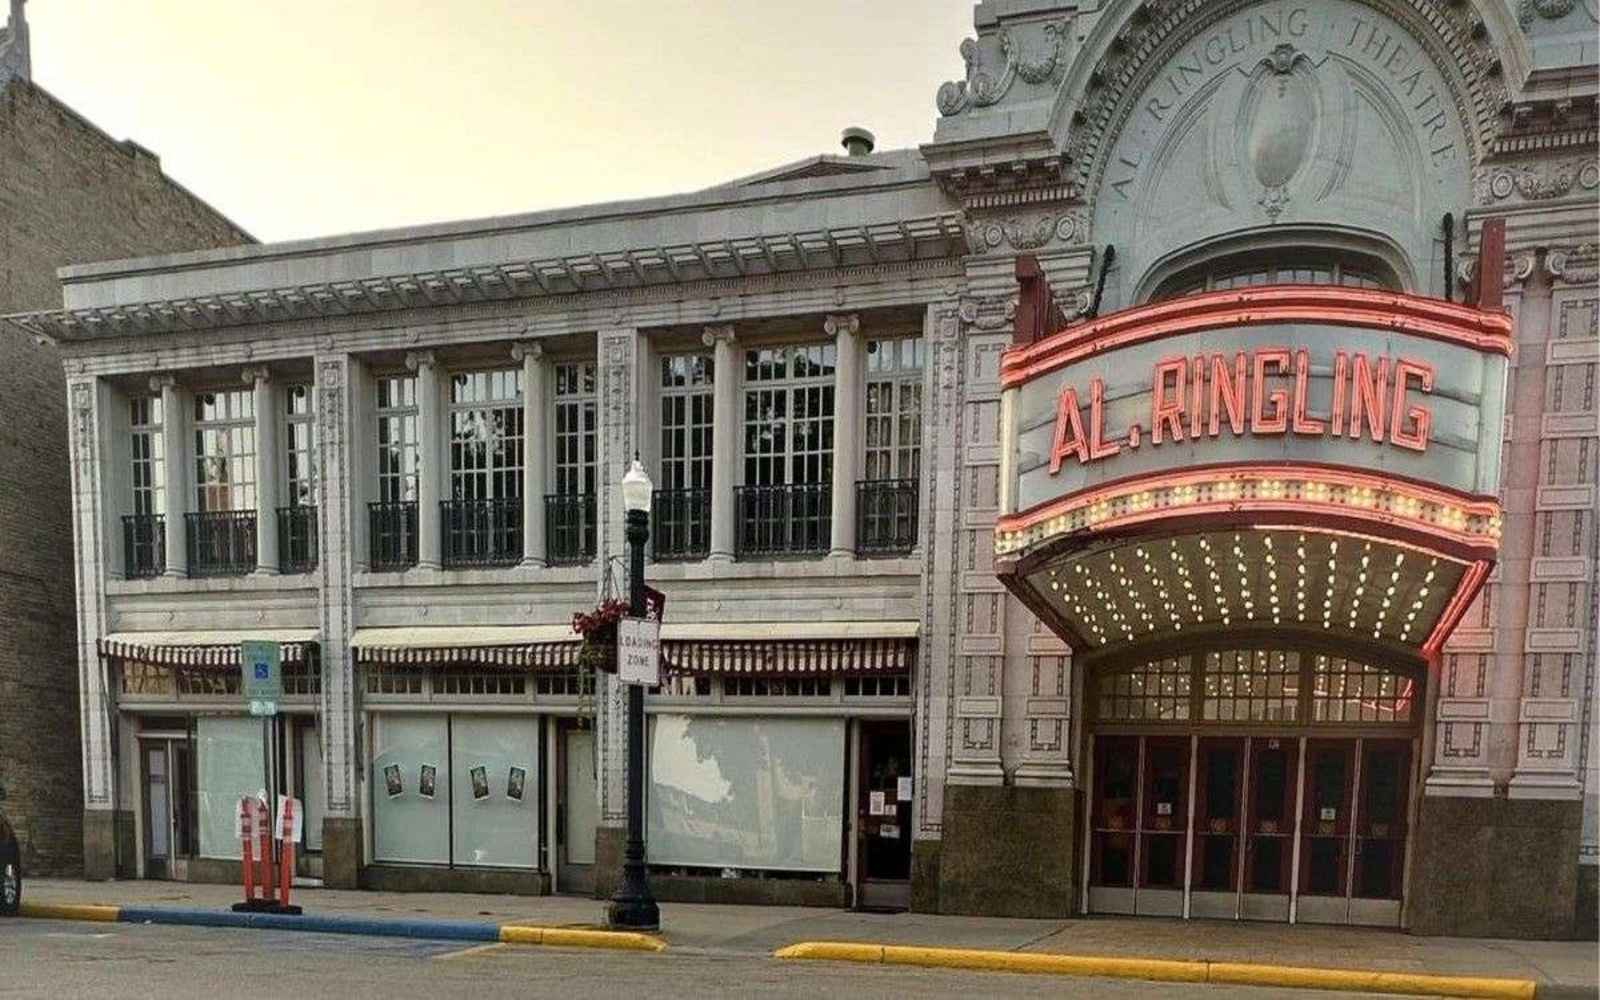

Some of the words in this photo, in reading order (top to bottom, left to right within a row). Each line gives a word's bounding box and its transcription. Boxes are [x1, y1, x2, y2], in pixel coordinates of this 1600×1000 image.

[1110, 152, 1143, 200] AL
[1145, 8, 1308, 121] RINGLING
[1346, 16, 1457, 169] THEATRE
[1151, 346, 1434, 453] RINGLING
[620, 635, 659, 649] LOADING
[627, 653, 650, 667] ZONE
